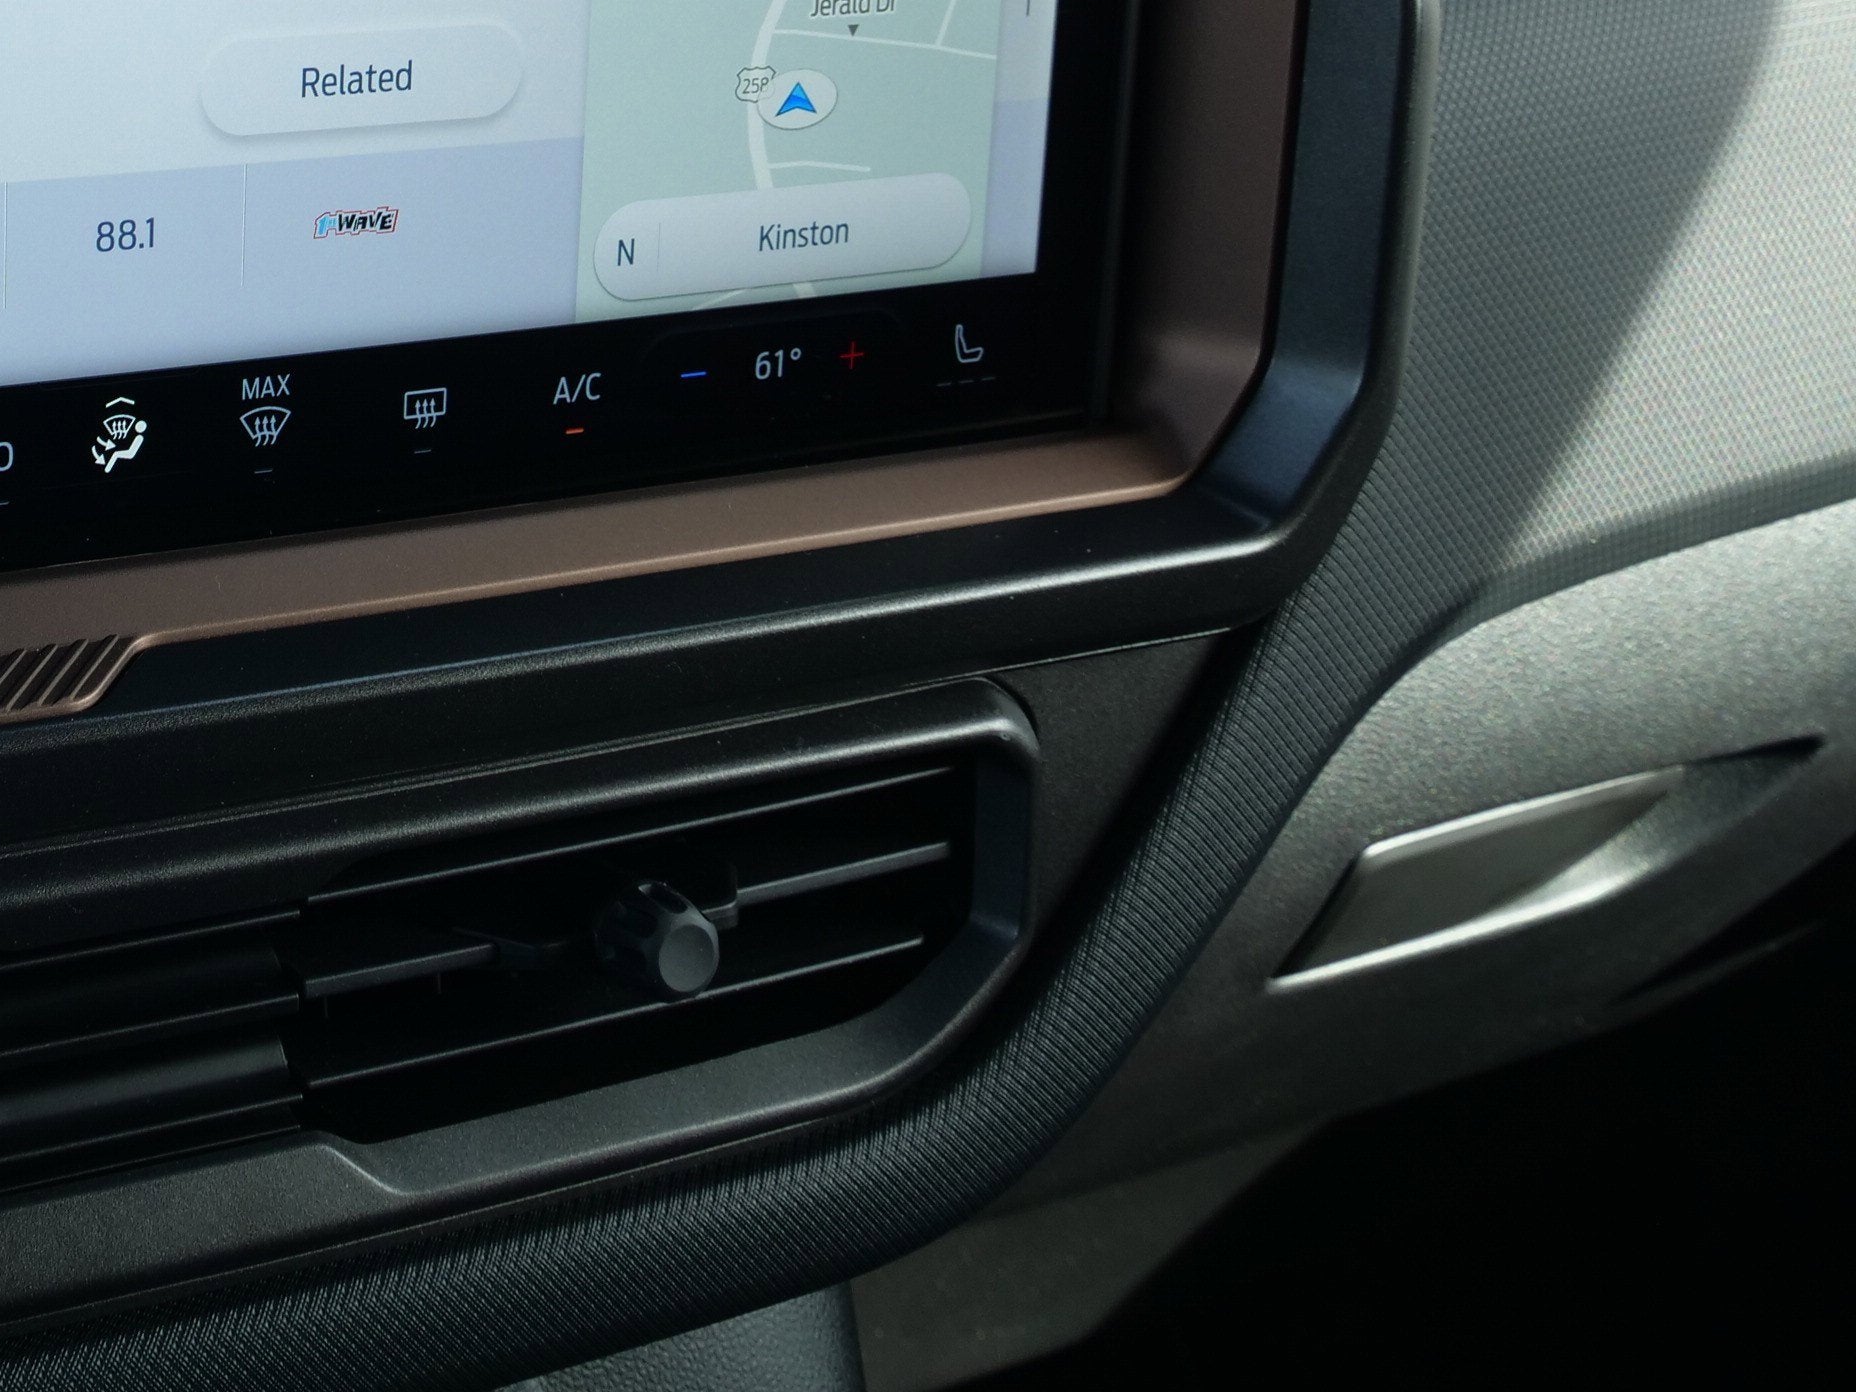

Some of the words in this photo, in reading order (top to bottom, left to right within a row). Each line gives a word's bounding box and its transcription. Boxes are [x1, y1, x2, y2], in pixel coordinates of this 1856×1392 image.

[300, 59, 414, 99] Related
[94, 217, 156, 253] 88.1
[337, 211, 395, 232] WAVE
[616, 238, 636, 267] N
[758, 221, 850, 252] Kinston
[754, 347, 803, 381] 61°
[241, 372, 292, 401] MAX
[552, 372, 602, 405] A/C
